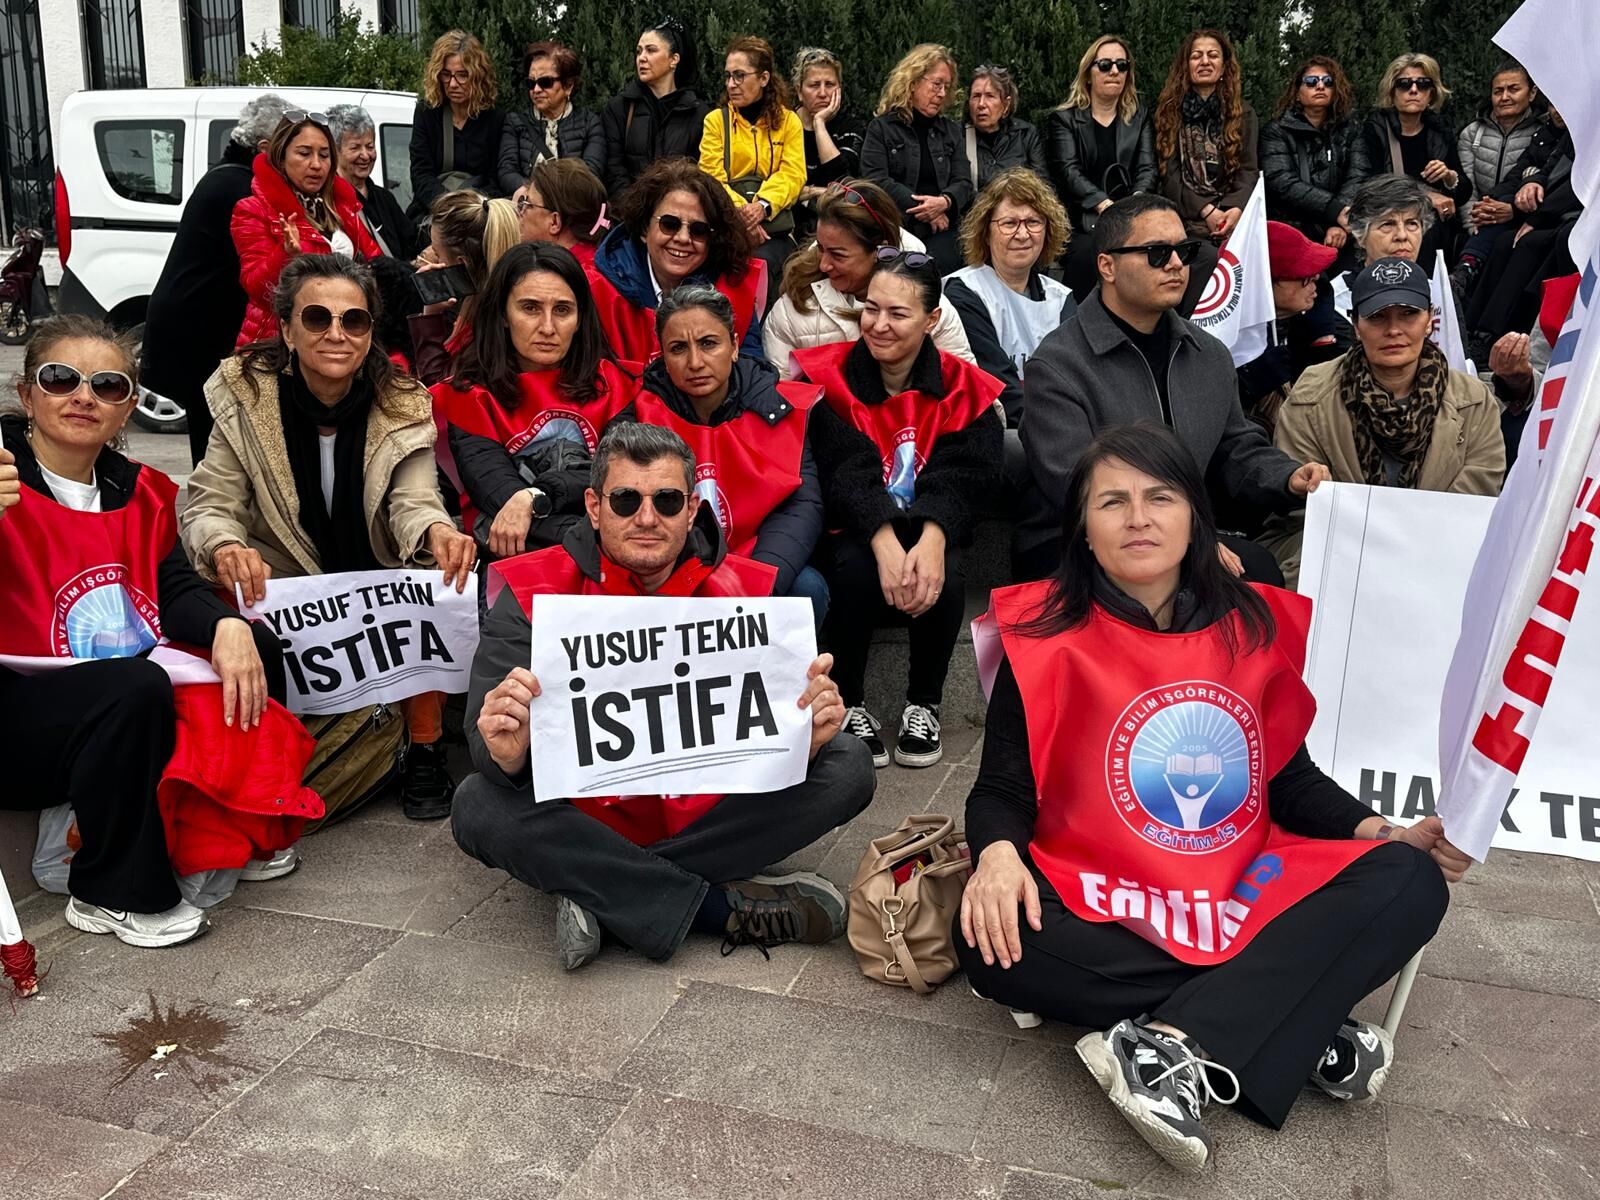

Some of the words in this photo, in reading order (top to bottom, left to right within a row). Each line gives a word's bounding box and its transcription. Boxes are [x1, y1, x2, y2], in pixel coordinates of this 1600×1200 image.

[264, 592, 351, 635] YUSUF
[356, 576, 434, 609] TEKİN
[279, 613, 455, 695] İSTİFA
[561, 626, 667, 671] YUSUF
[674, 606, 769, 656] TEKİN
[569, 662, 779, 767] İSTİFA
[1124, 697, 1158, 731] BİLİM
[1159, 686, 1254, 728] İŞGÖRENLERİ
[1115, 733, 1130, 752] VE
[1182, 744, 1208, 752] 2005
[1111, 757, 1136, 812] EĞİTİM
[1246, 730, 1260, 813] SENDİKASI
[1540, 791, 1600, 843] TE
